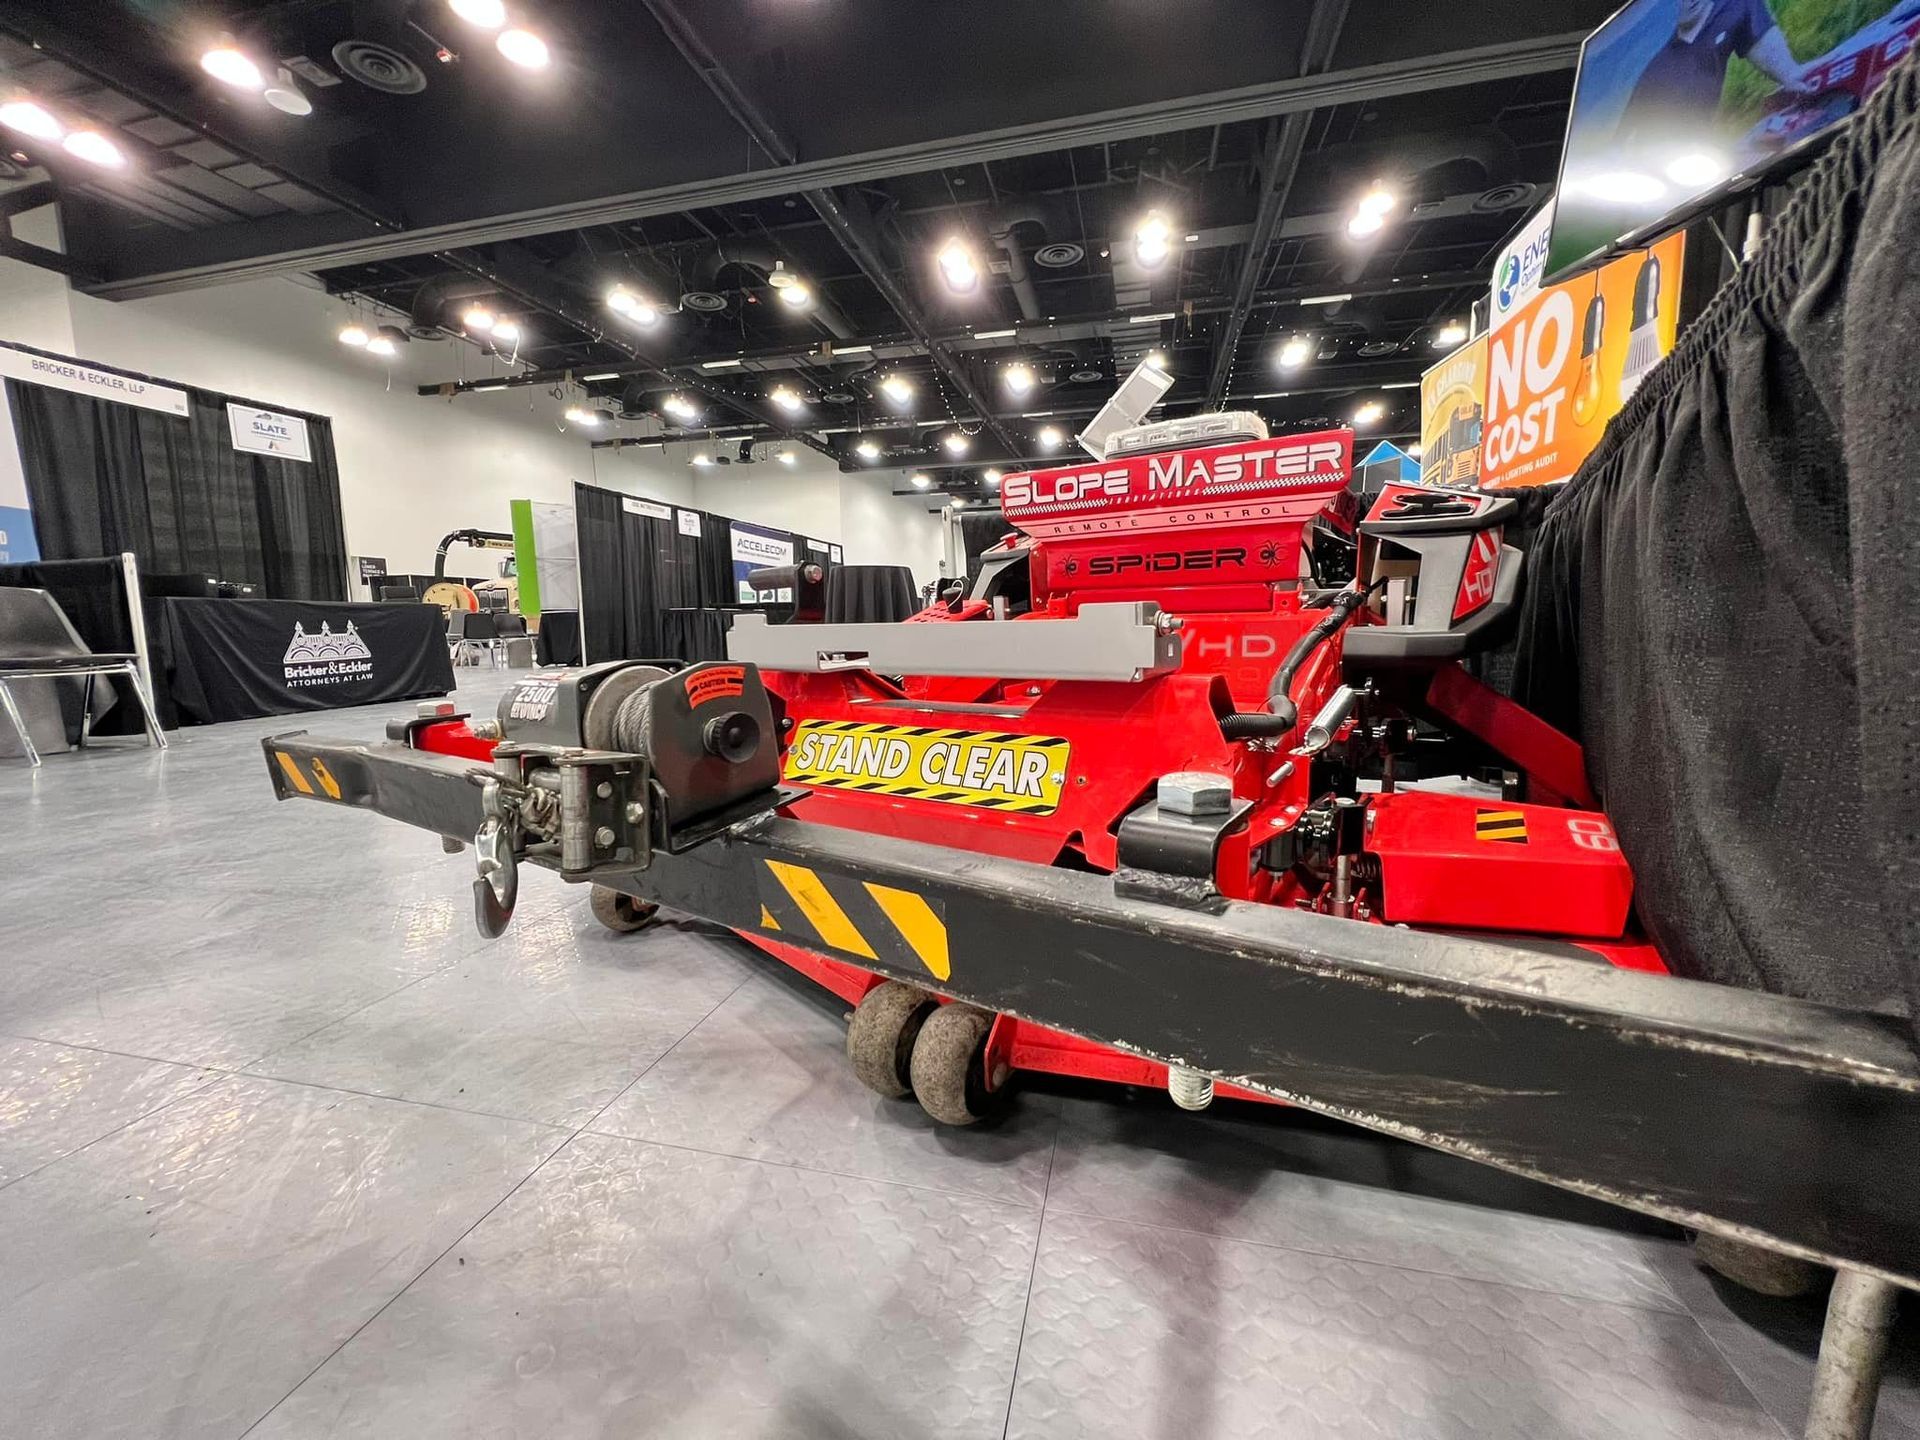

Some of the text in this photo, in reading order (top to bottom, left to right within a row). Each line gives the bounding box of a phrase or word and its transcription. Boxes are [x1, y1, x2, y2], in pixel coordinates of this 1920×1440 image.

[1487, 290, 1575, 424] NO
[31, 359, 146, 394] BRICKER & ECKLER, LLP
[252, 421, 288, 436] SLATE
[1485, 386, 1567, 472] COST
[1004, 441, 1342, 507] SLOPE MASTER
[1505, 462, 1535, 481] LIGHTING
[1535, 451, 1559, 469] AUDIT
[1054, 506, 1291, 534] REMOTE CONTROL
[737, 538, 787, 556] ACCELECOM
[1465, 566, 1494, 603] HD
[286, 677, 340, 688] ATTORNEYS
[356, 673, 374, 681] LAW
[515, 686, 557, 703] 2500
[699, 677, 727, 690] CAUTION
[795, 732, 1050, 798] STAND CLEAR
